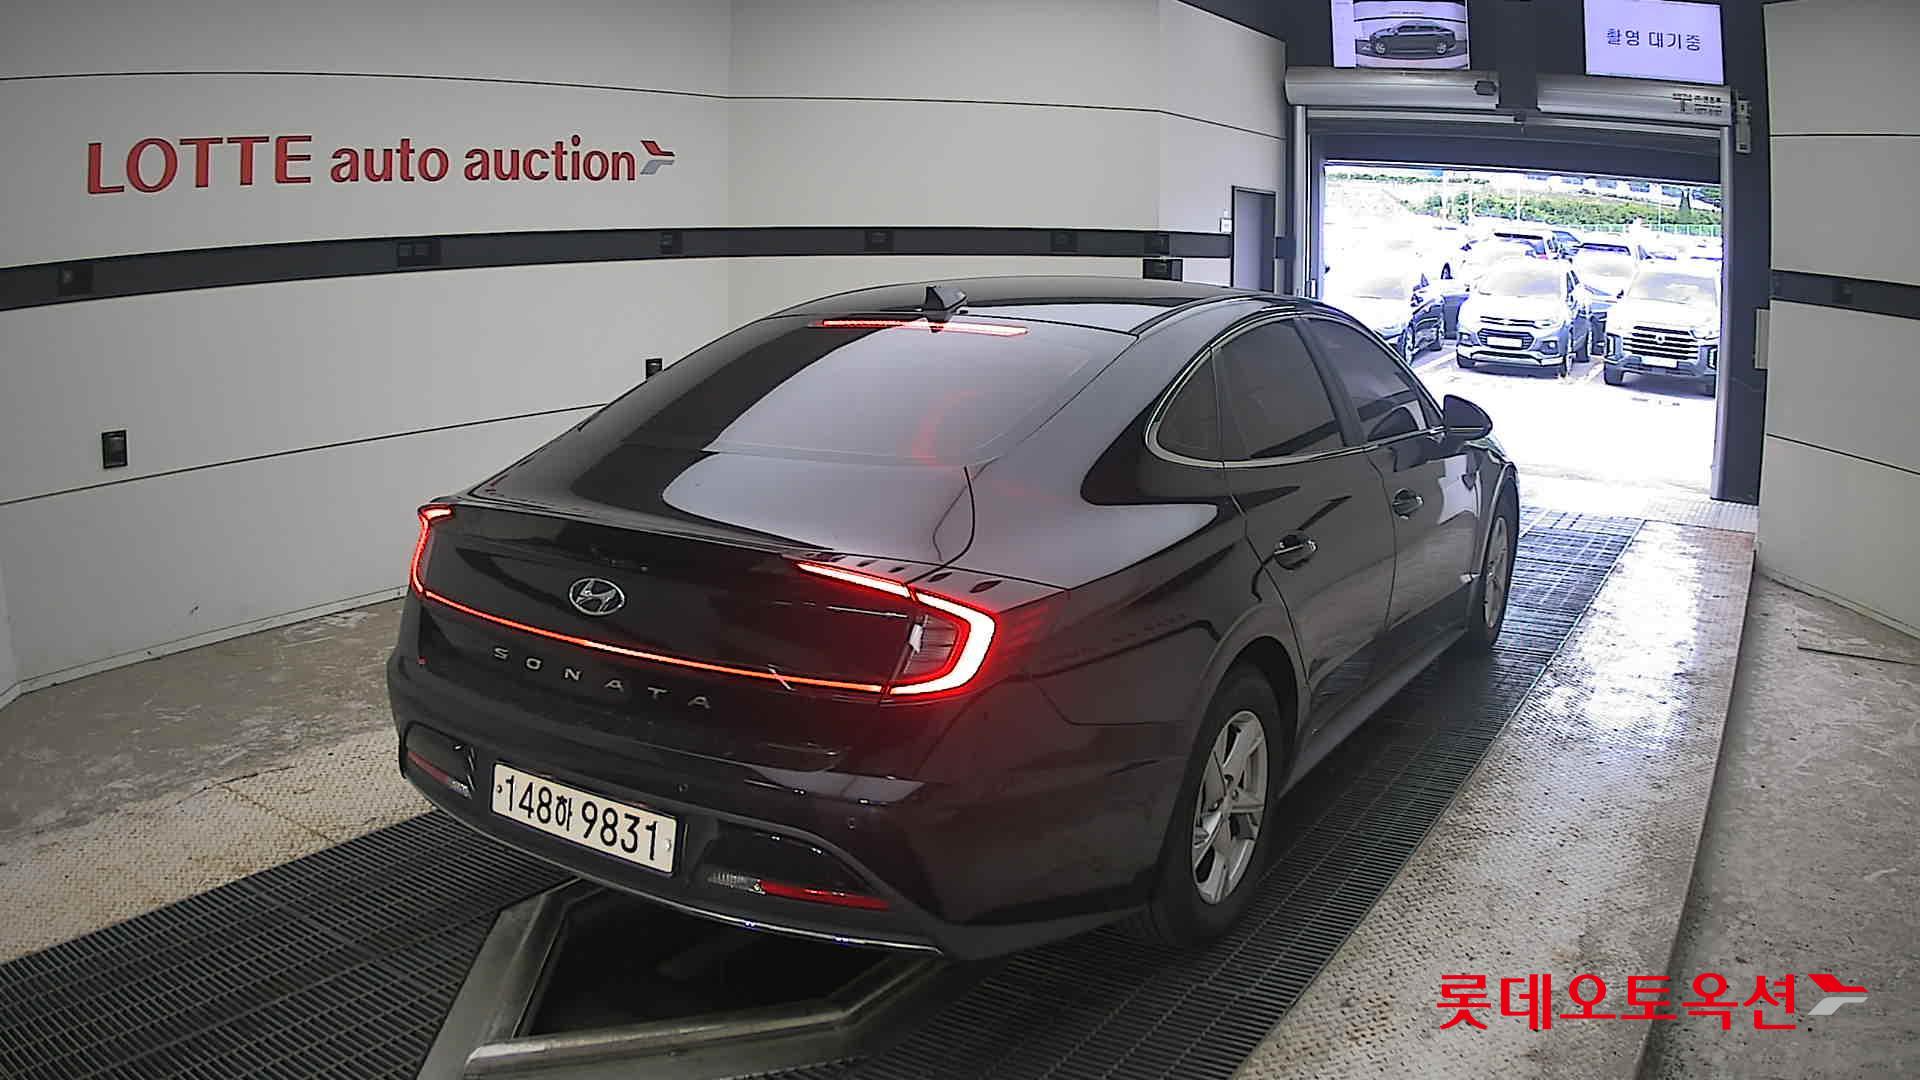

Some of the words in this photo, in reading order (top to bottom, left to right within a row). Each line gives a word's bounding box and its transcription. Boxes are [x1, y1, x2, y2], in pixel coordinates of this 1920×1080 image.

[1648, 31, 1700, 51] 대기중
[87, 135, 312, 194] LOTTE
[330, 138, 449, 183] auto
[463, 134, 637, 182] auction
[493, 647, 711, 710] SONATA
[505, 775, 573, 832] 148하
[581, 800, 658, 861] 9831
